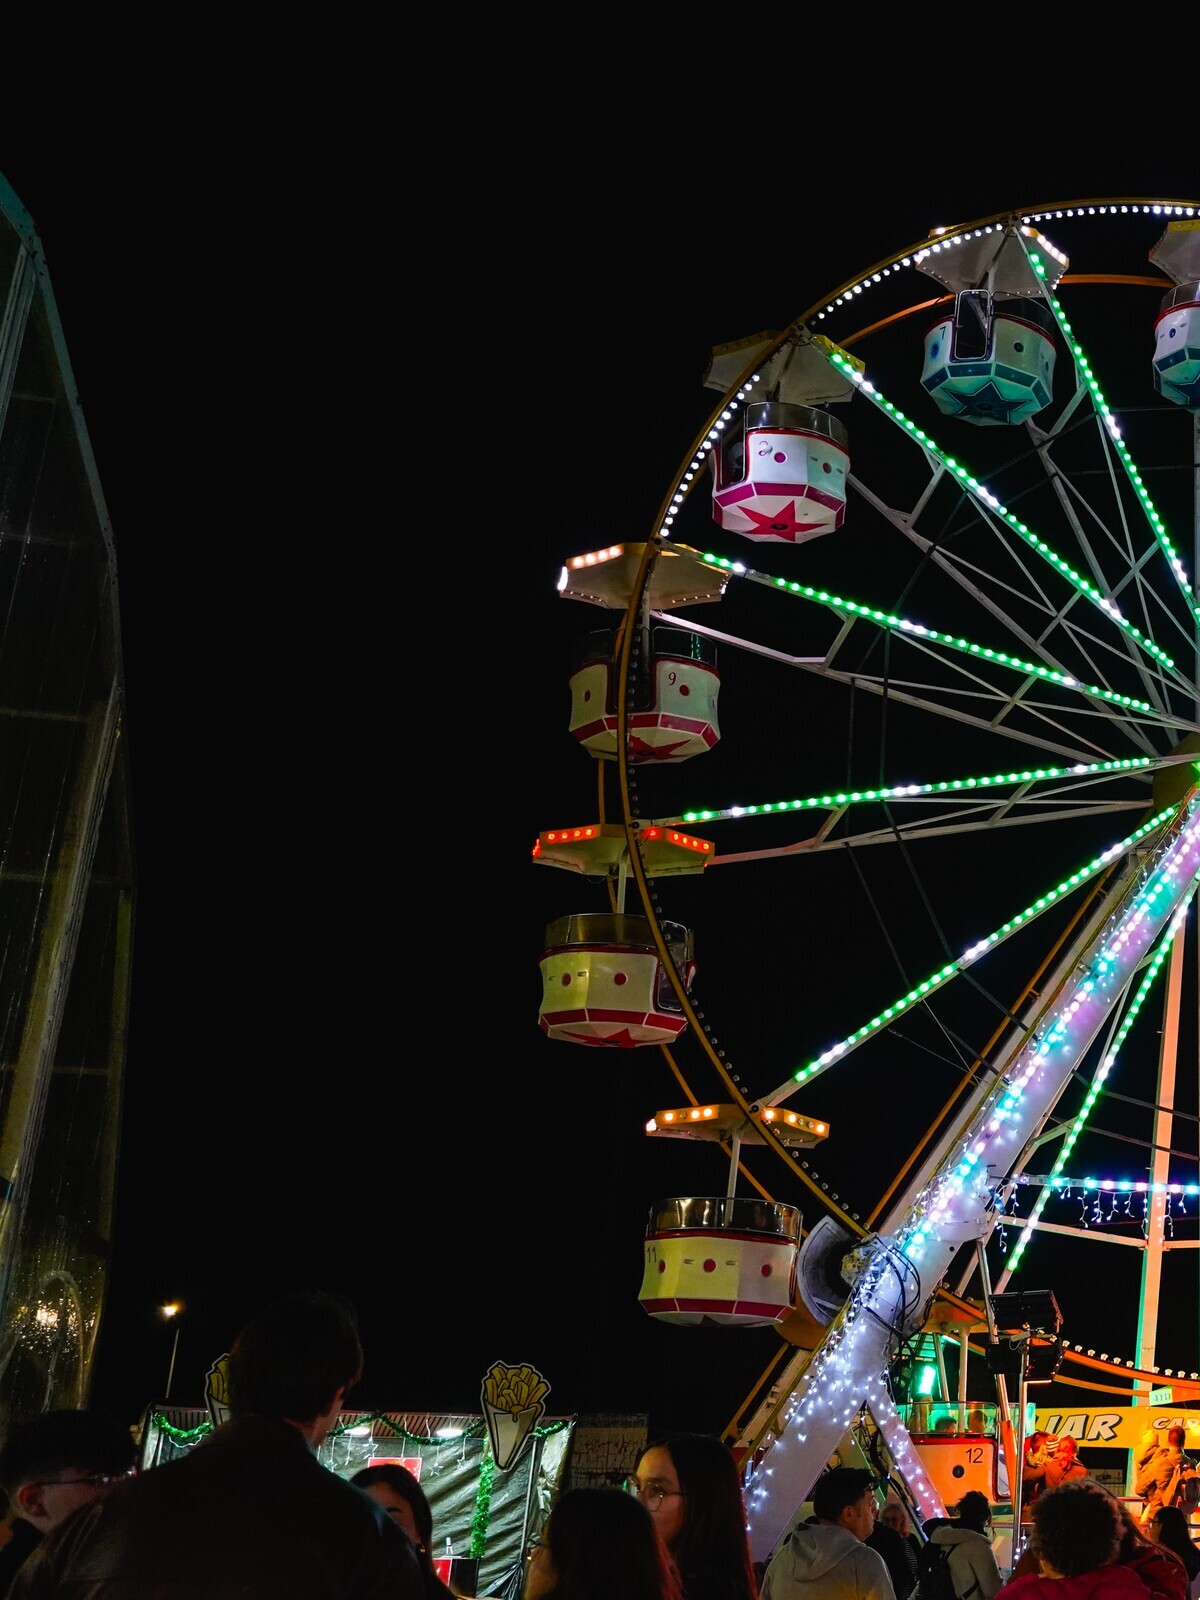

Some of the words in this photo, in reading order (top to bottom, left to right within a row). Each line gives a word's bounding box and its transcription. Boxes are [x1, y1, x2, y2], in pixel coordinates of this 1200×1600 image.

[939, 325, 947, 340] 7
[668, 671, 677, 686] 9
[646, 1246, 657, 1264] 11
[1035, 1414, 1123, 1441] IAR
[965, 1447, 984, 1464] 12
